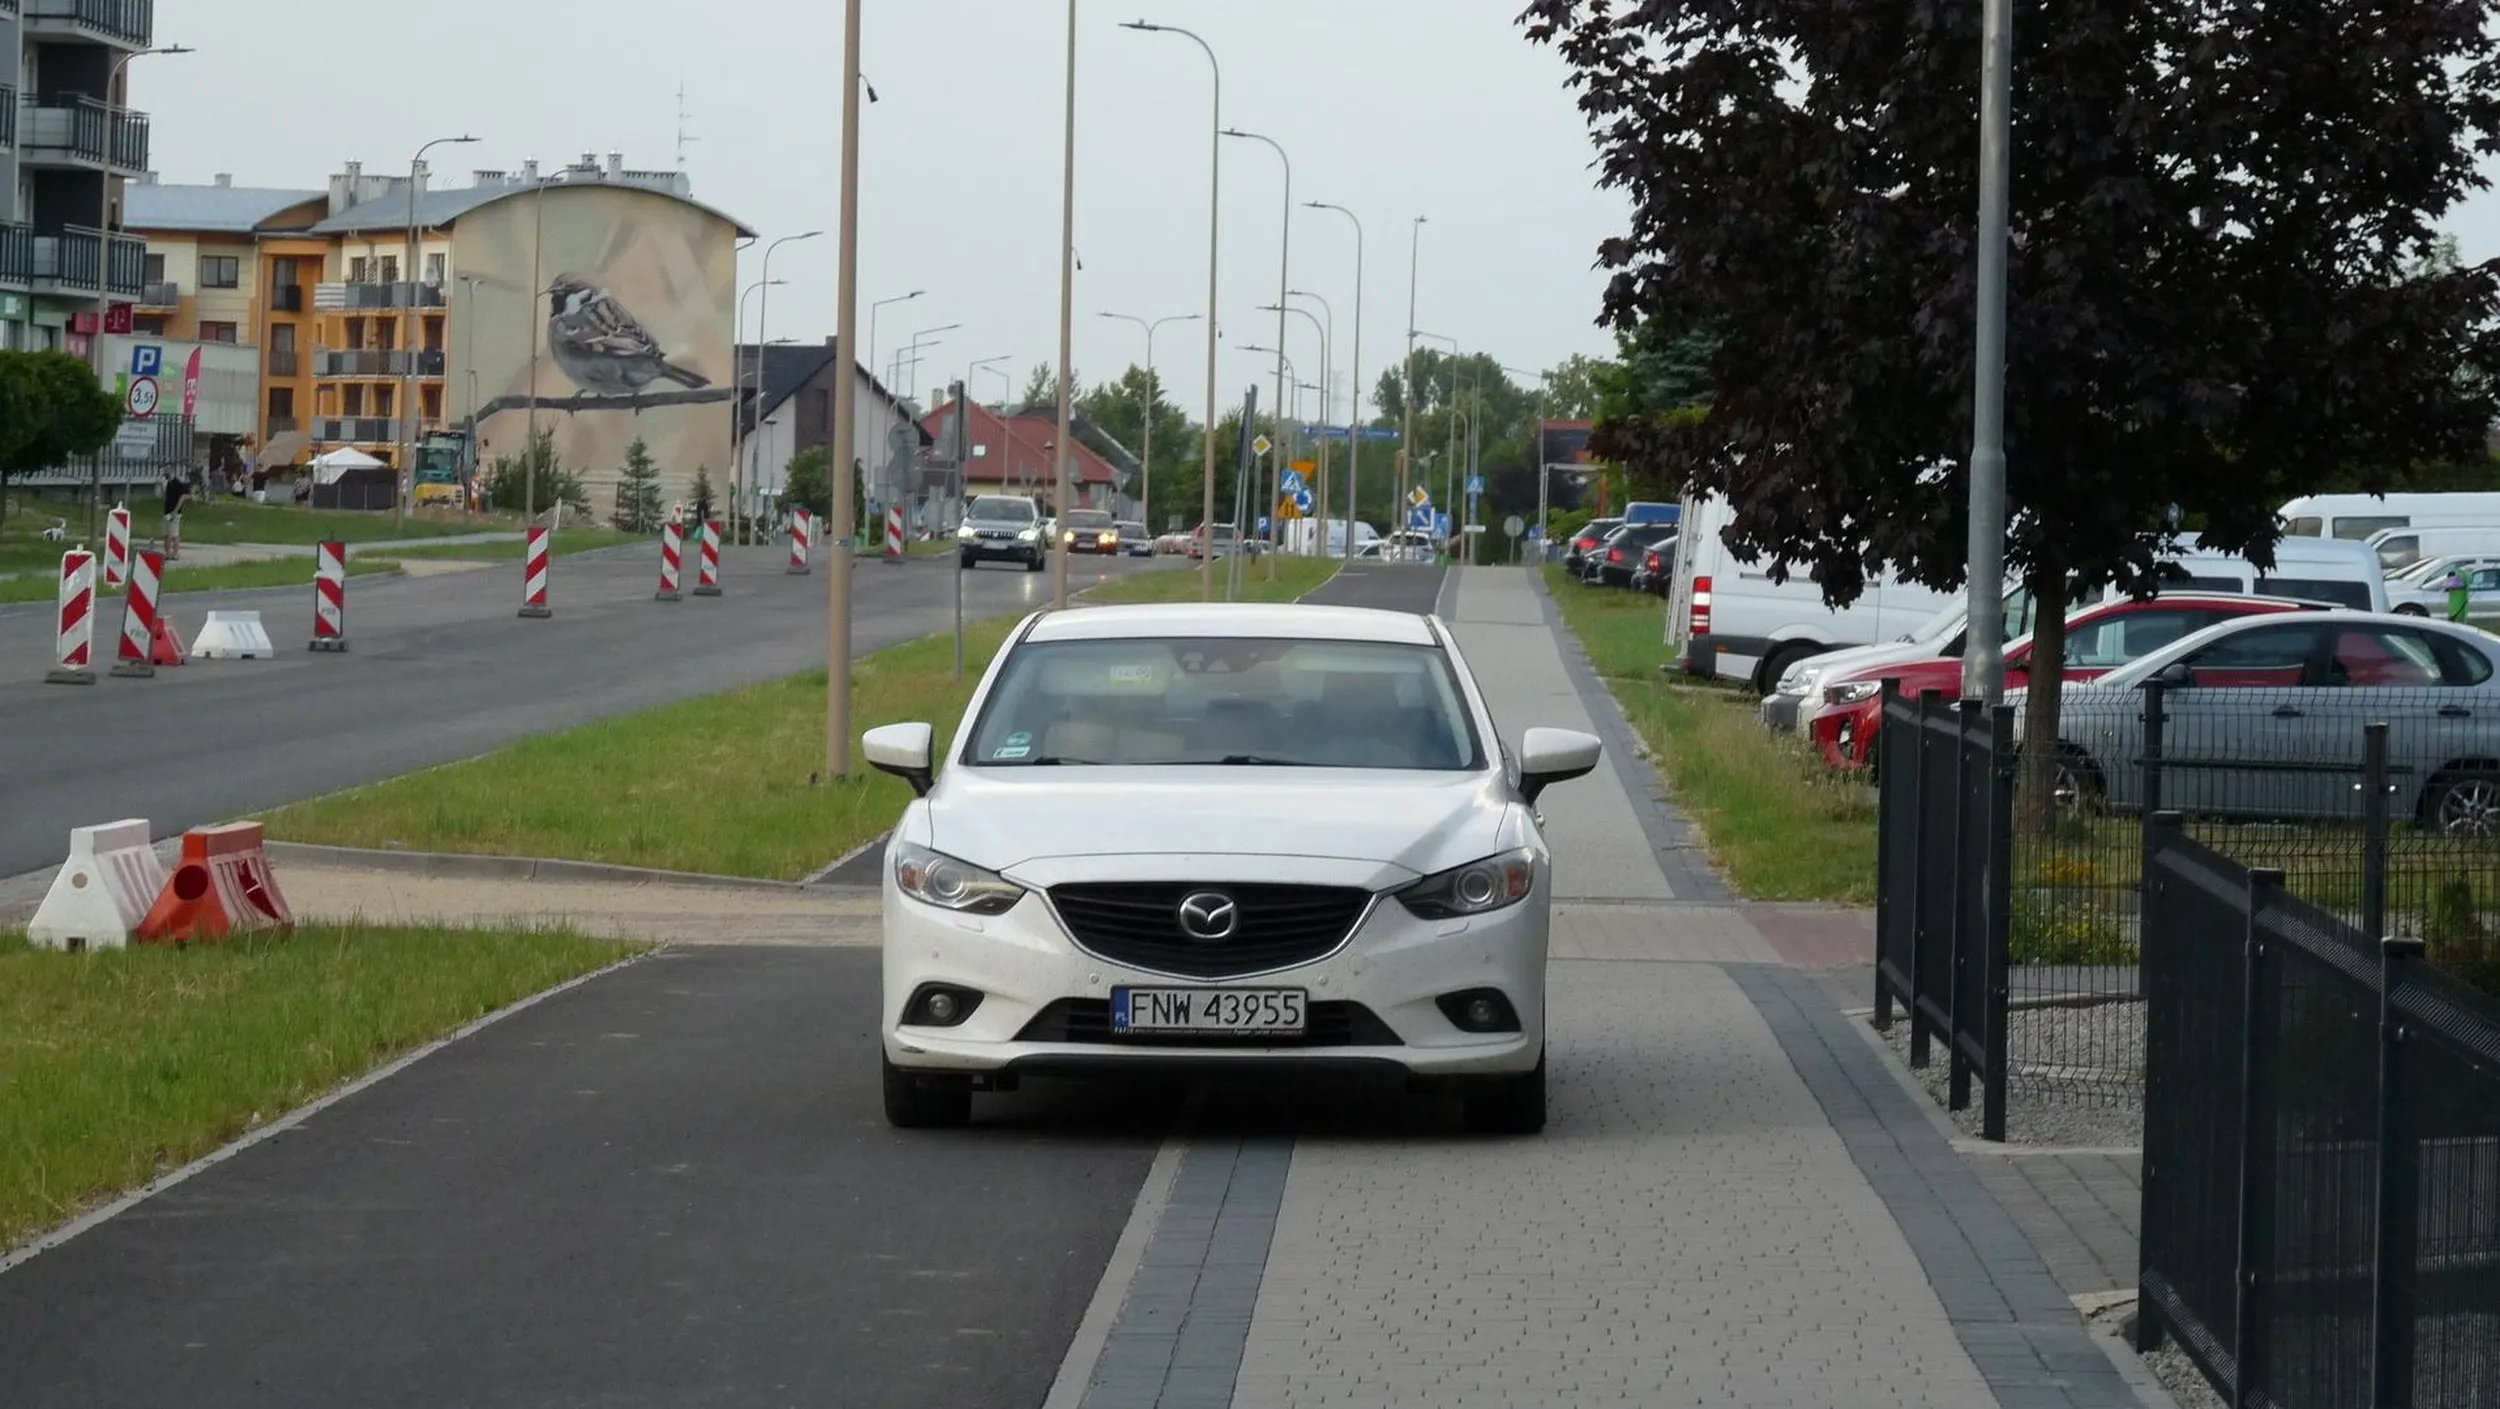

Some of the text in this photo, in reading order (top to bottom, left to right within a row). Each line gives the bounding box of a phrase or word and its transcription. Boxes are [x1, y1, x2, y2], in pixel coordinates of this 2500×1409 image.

[137, 348, 156, 373] P
[1115, 1011, 1128, 1022] PL
[1131, 993, 1299, 1025] FNW 43955
